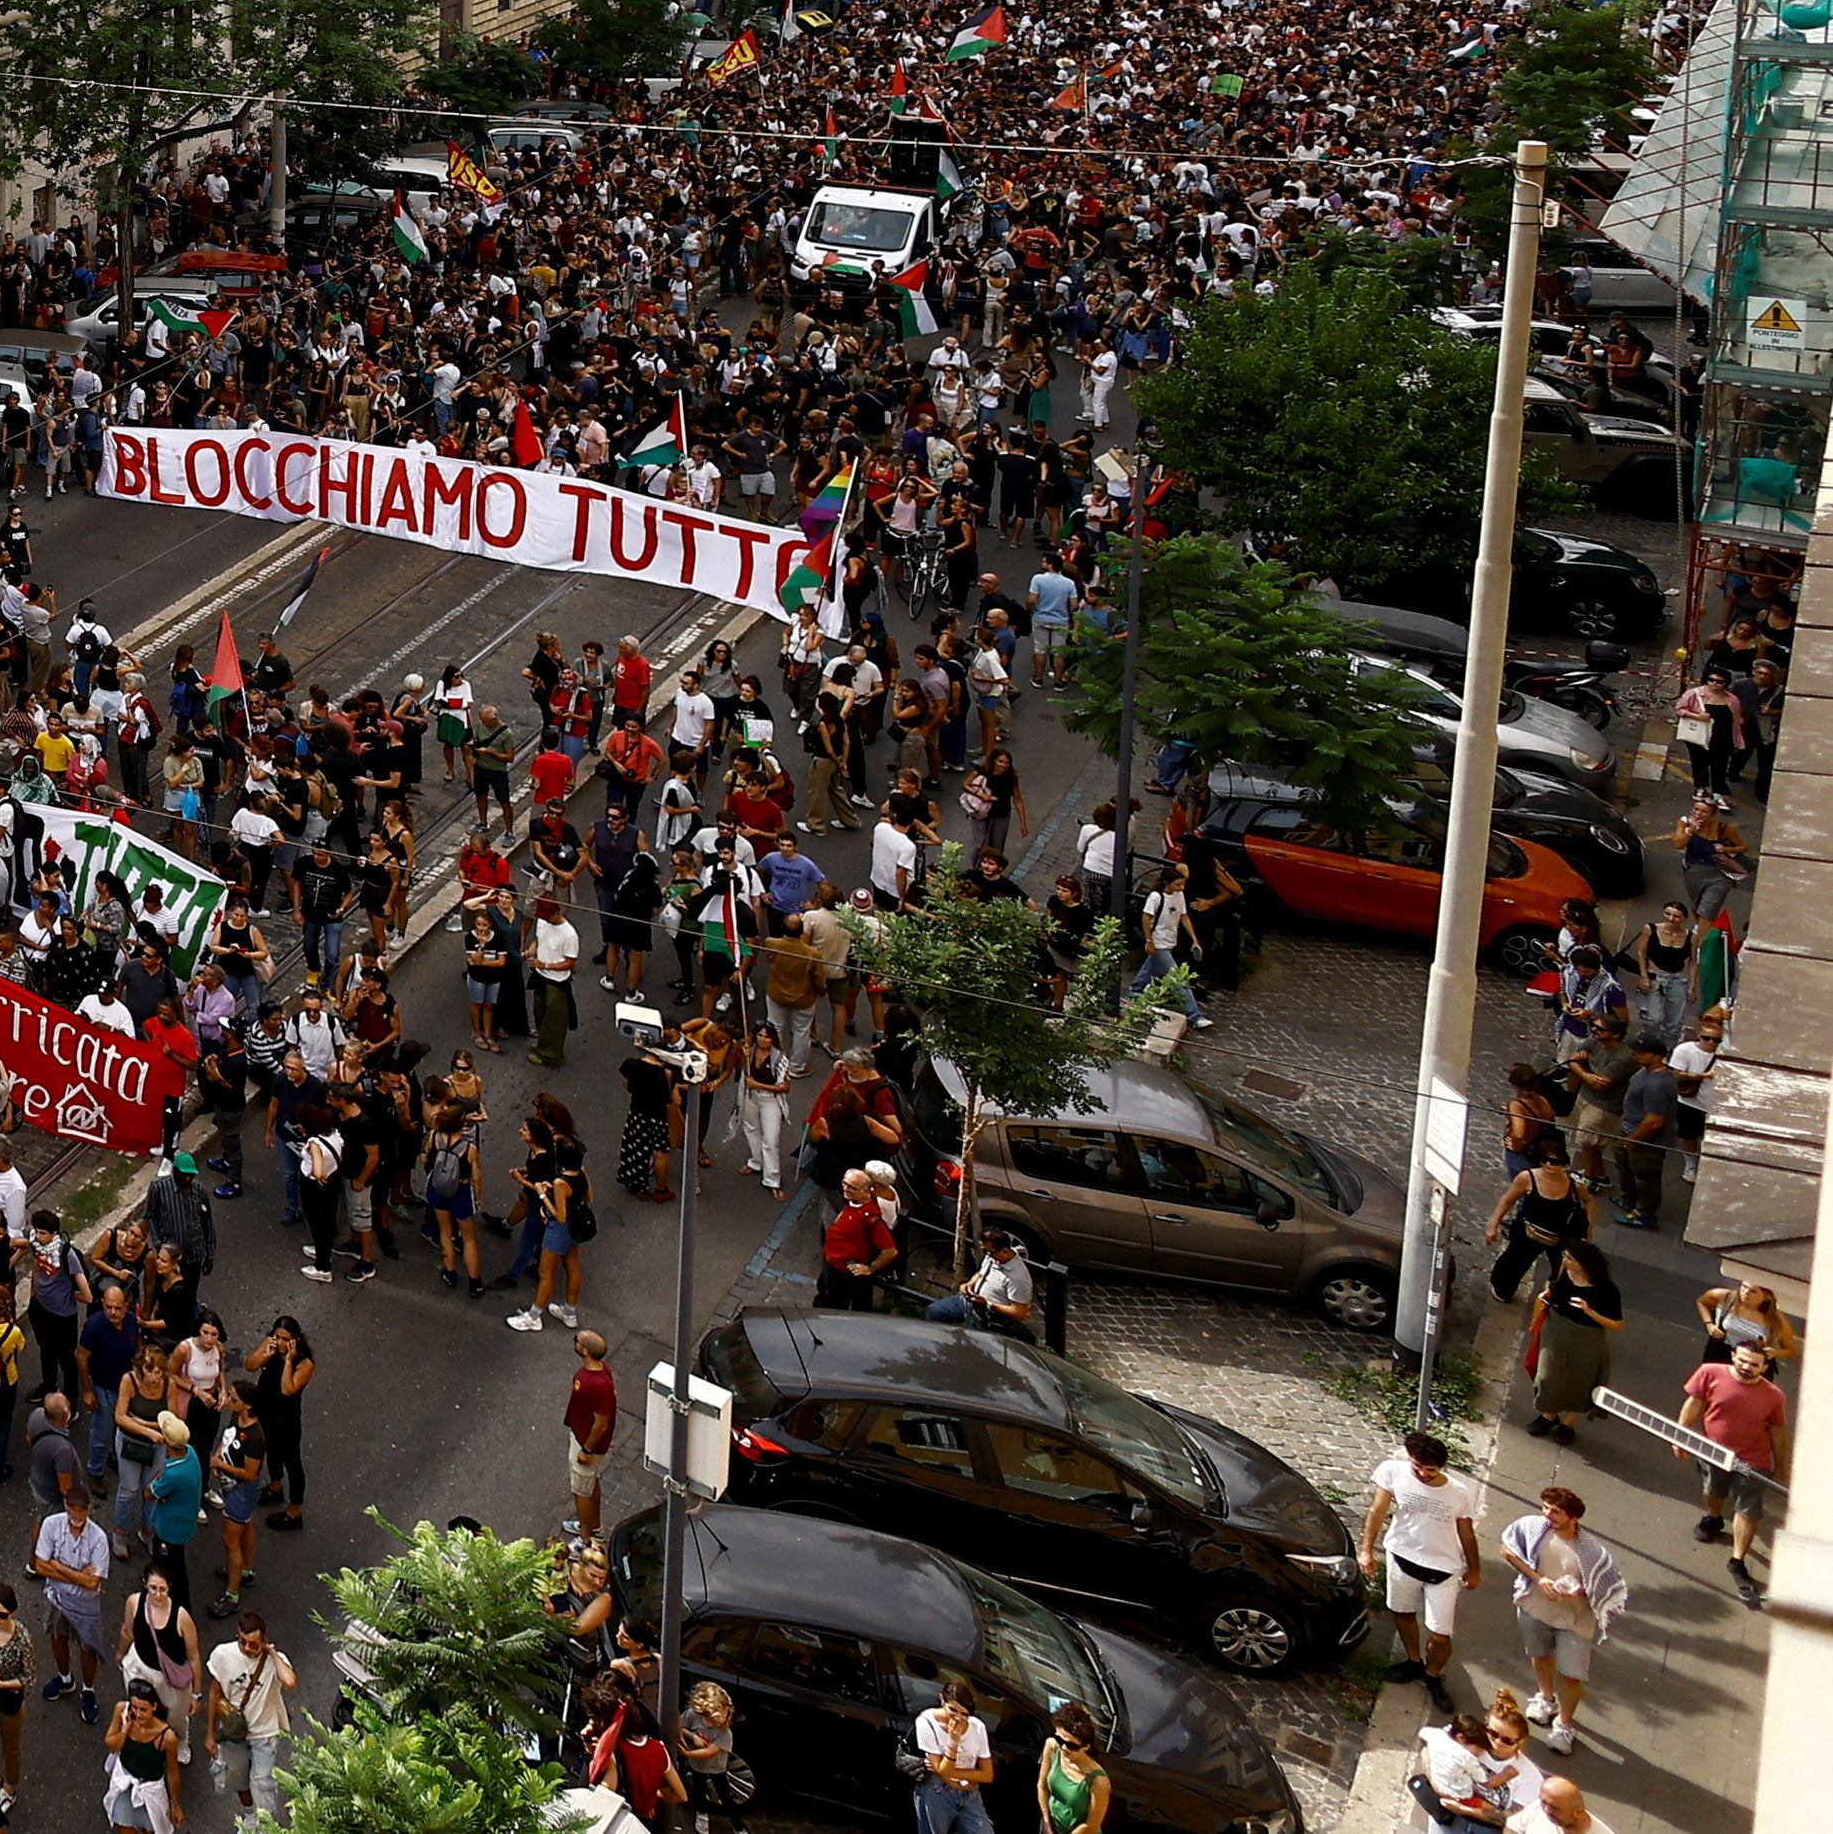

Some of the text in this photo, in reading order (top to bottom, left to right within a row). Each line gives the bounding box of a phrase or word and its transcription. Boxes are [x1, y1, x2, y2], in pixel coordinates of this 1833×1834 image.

[1753, 329, 1799, 339] PONTEGGIO
[1749, 344, 1801, 354] ALLESTIMENTO
[114, 432, 526, 548] BLOCCHIAMO
